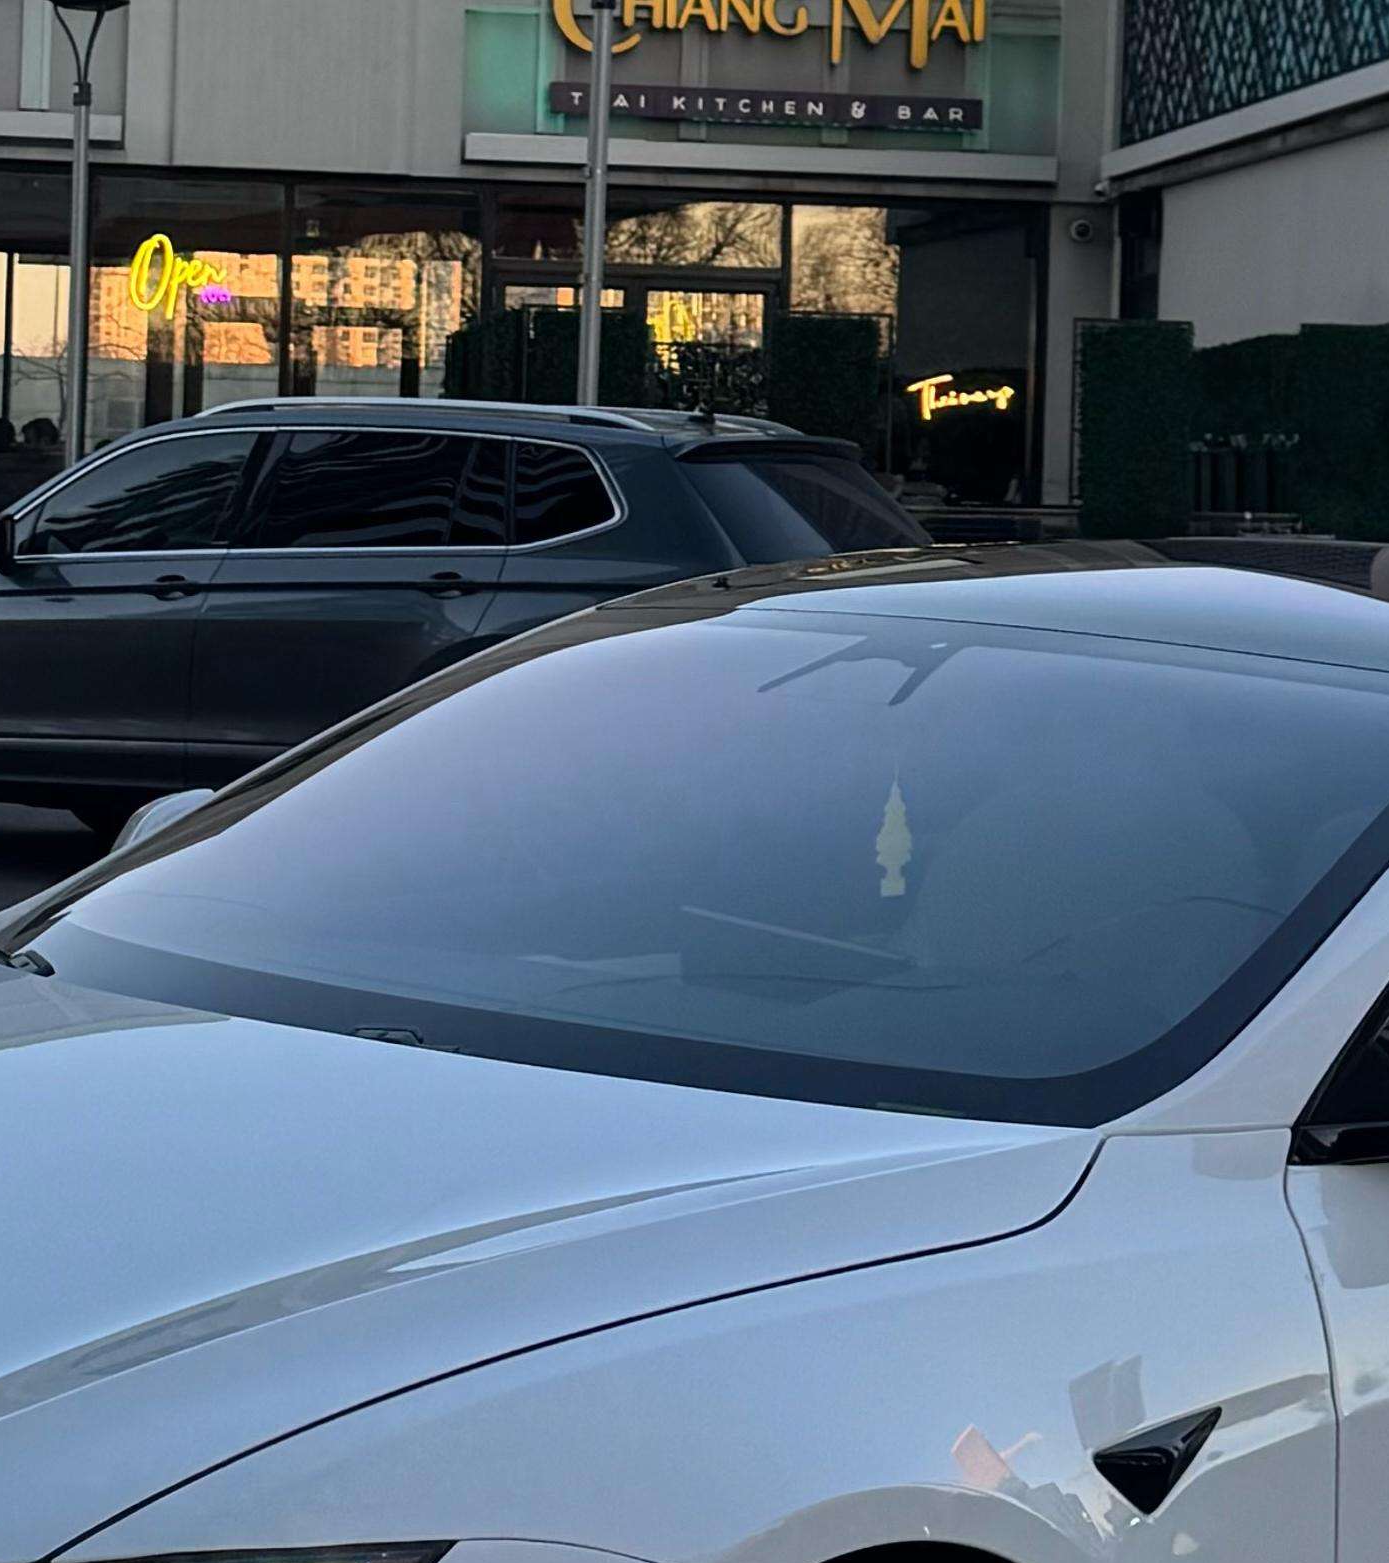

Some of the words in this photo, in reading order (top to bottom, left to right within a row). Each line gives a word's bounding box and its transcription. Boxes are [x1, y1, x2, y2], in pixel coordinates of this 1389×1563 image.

[571, 91, 645, 109] TAI
[673, 95, 824, 116] KITCHEN
[851, 102, 866, 119] &
[898, 105, 964, 121] BAR
[130, 233, 228, 320] Open
